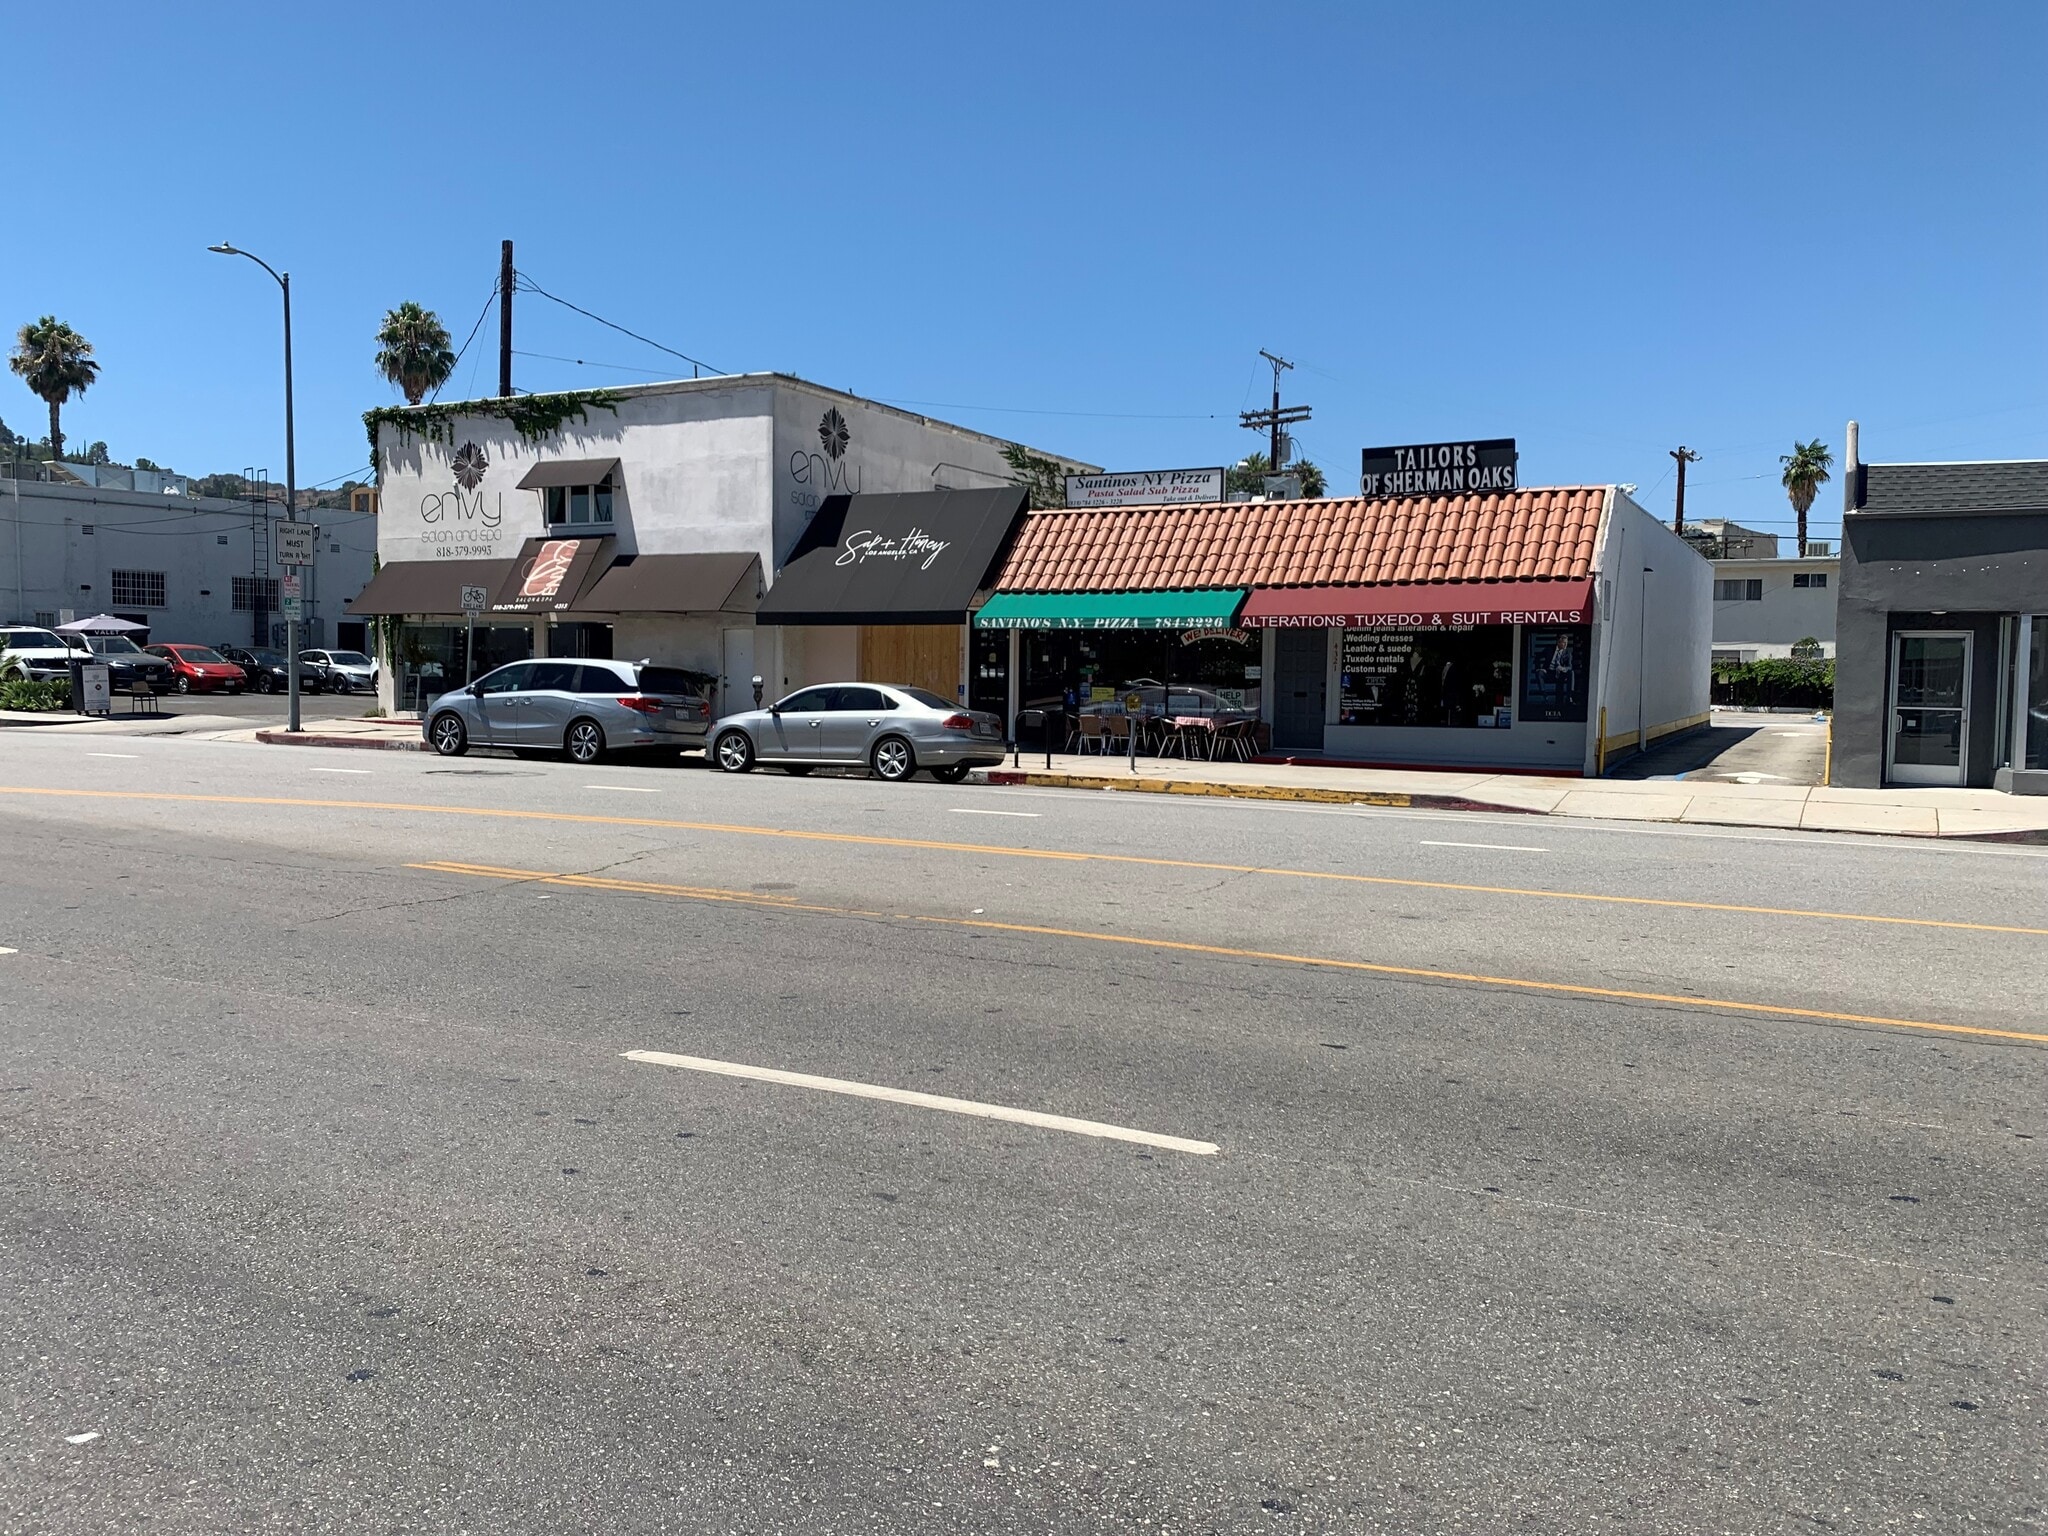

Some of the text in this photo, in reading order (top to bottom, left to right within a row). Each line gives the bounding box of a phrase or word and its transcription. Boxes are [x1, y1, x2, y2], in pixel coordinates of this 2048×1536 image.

[1394, 444, 1476, 470] TAILORS
[1076, 472, 1212, 489] Santinos NY Pizza
[1360, 466, 1513, 494] OF SHERMAN OAKS
[1088, 486, 1200, 498] Pasta Salad Sub Pizza
[421, 491, 501, 528] envy
[421, 528, 502, 543] salon and spa
[436, 546, 492, 558] 818-379-9993
[835, 530, 882, 566] Sap
[901, 527, 951, 570] Honey
[980, 617, 1223, 628] SANTINO'S N.Y. PIZZA 784-3226
[1242, 611, 1581, 627] ALTERATIONS TUXEDO & SUIT RENTALS
[1448, 624, 1474, 632] repair
[1382, 634, 1414, 642] dresses
[1387, 644, 1412, 652] suede
[1376, 654, 1404, 662] rentals
[1378, 664, 1398, 672] suits
